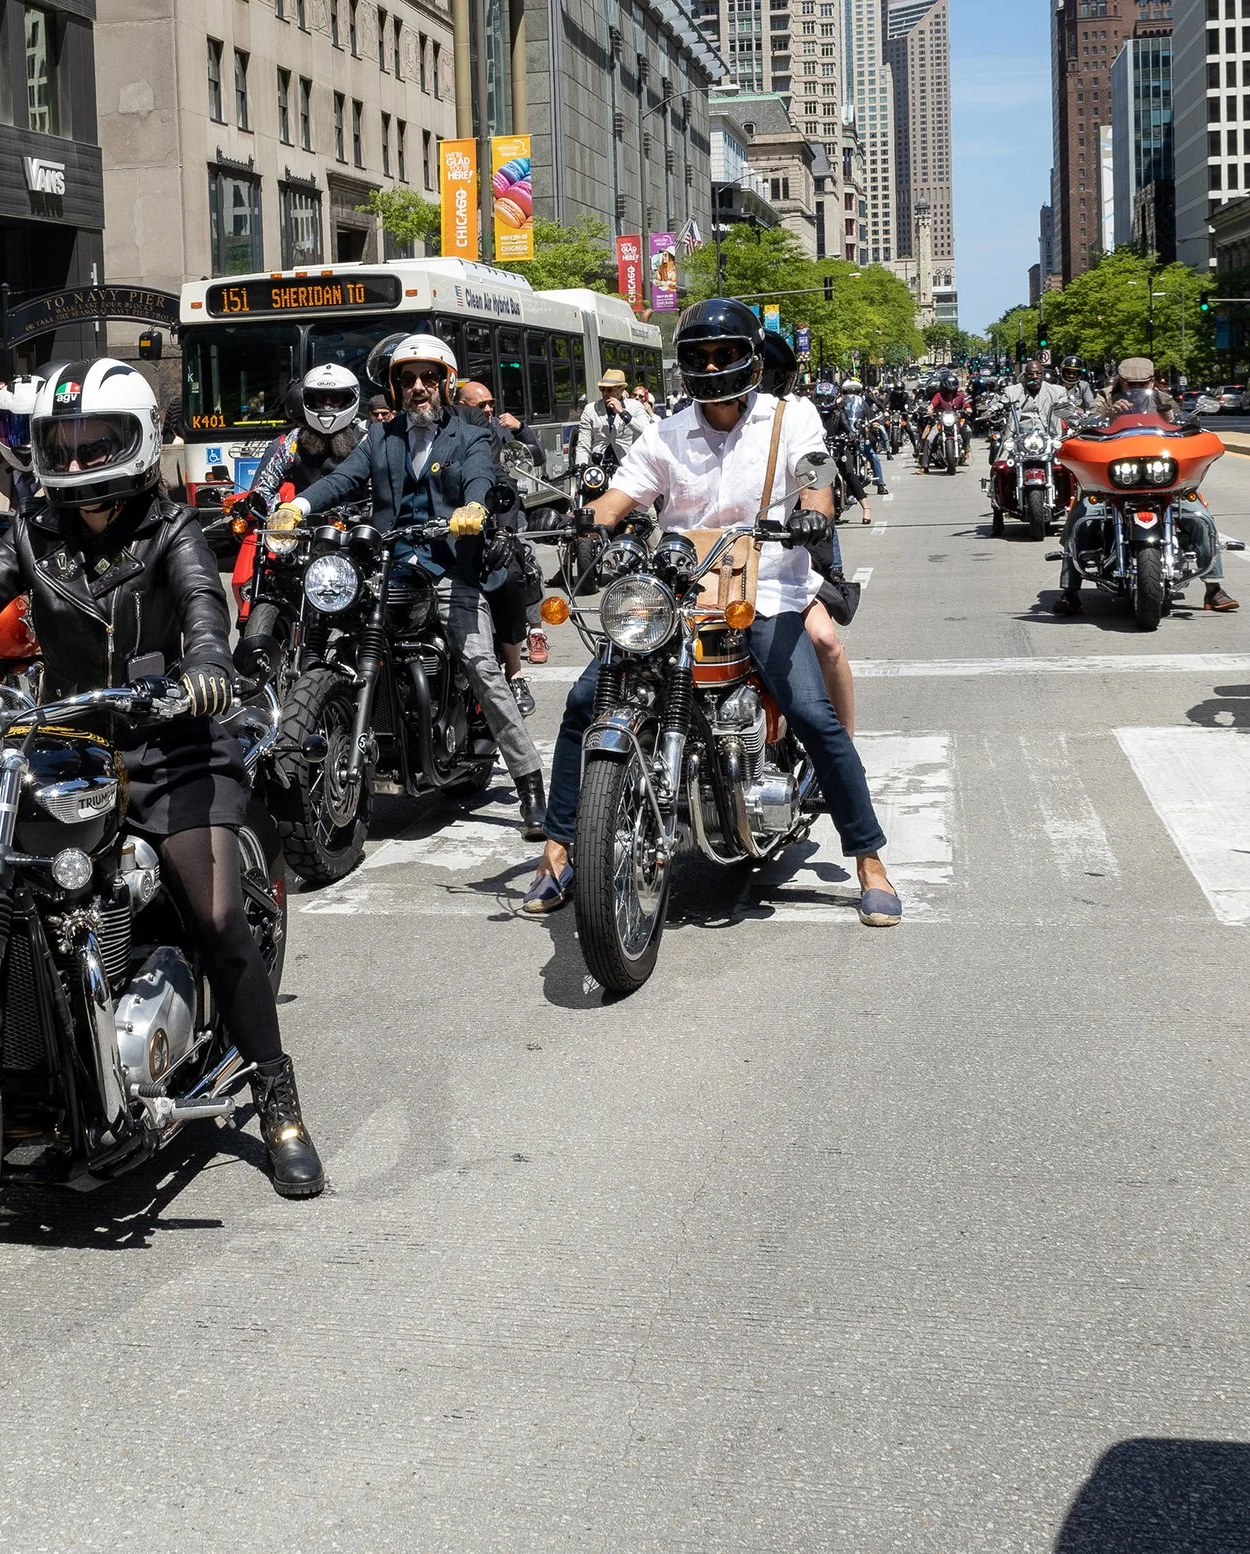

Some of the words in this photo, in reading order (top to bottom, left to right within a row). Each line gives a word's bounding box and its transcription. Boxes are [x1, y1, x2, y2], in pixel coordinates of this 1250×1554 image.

[446, 157, 470, 167] GLAD
[23, 156, 65, 195] VANS
[448, 170, 473, 184] HERE!
[455, 186, 468, 247] CHICAGO
[500, 244, 528, 252] CHICAGO
[622, 254, 639, 263] HERE!
[627, 265, 636, 303] CHICAGO
[43, 296, 65, 311] TO
[72, 290, 119, 304] NAVY
[129, 291, 165, 309] PIER
[222, 288, 250, 313] 151
[271, 285, 342, 309] SHERIDAN
[346, 284, 366, 304] TO
[465, 288, 483, 310] Clean
[483, 291, 492, 312] Air
[492, 293, 510, 316] Hybrid
[510, 296, 521, 316] Bus
[56, 393, 78, 404] agv
[192, 414, 226, 430] K401
